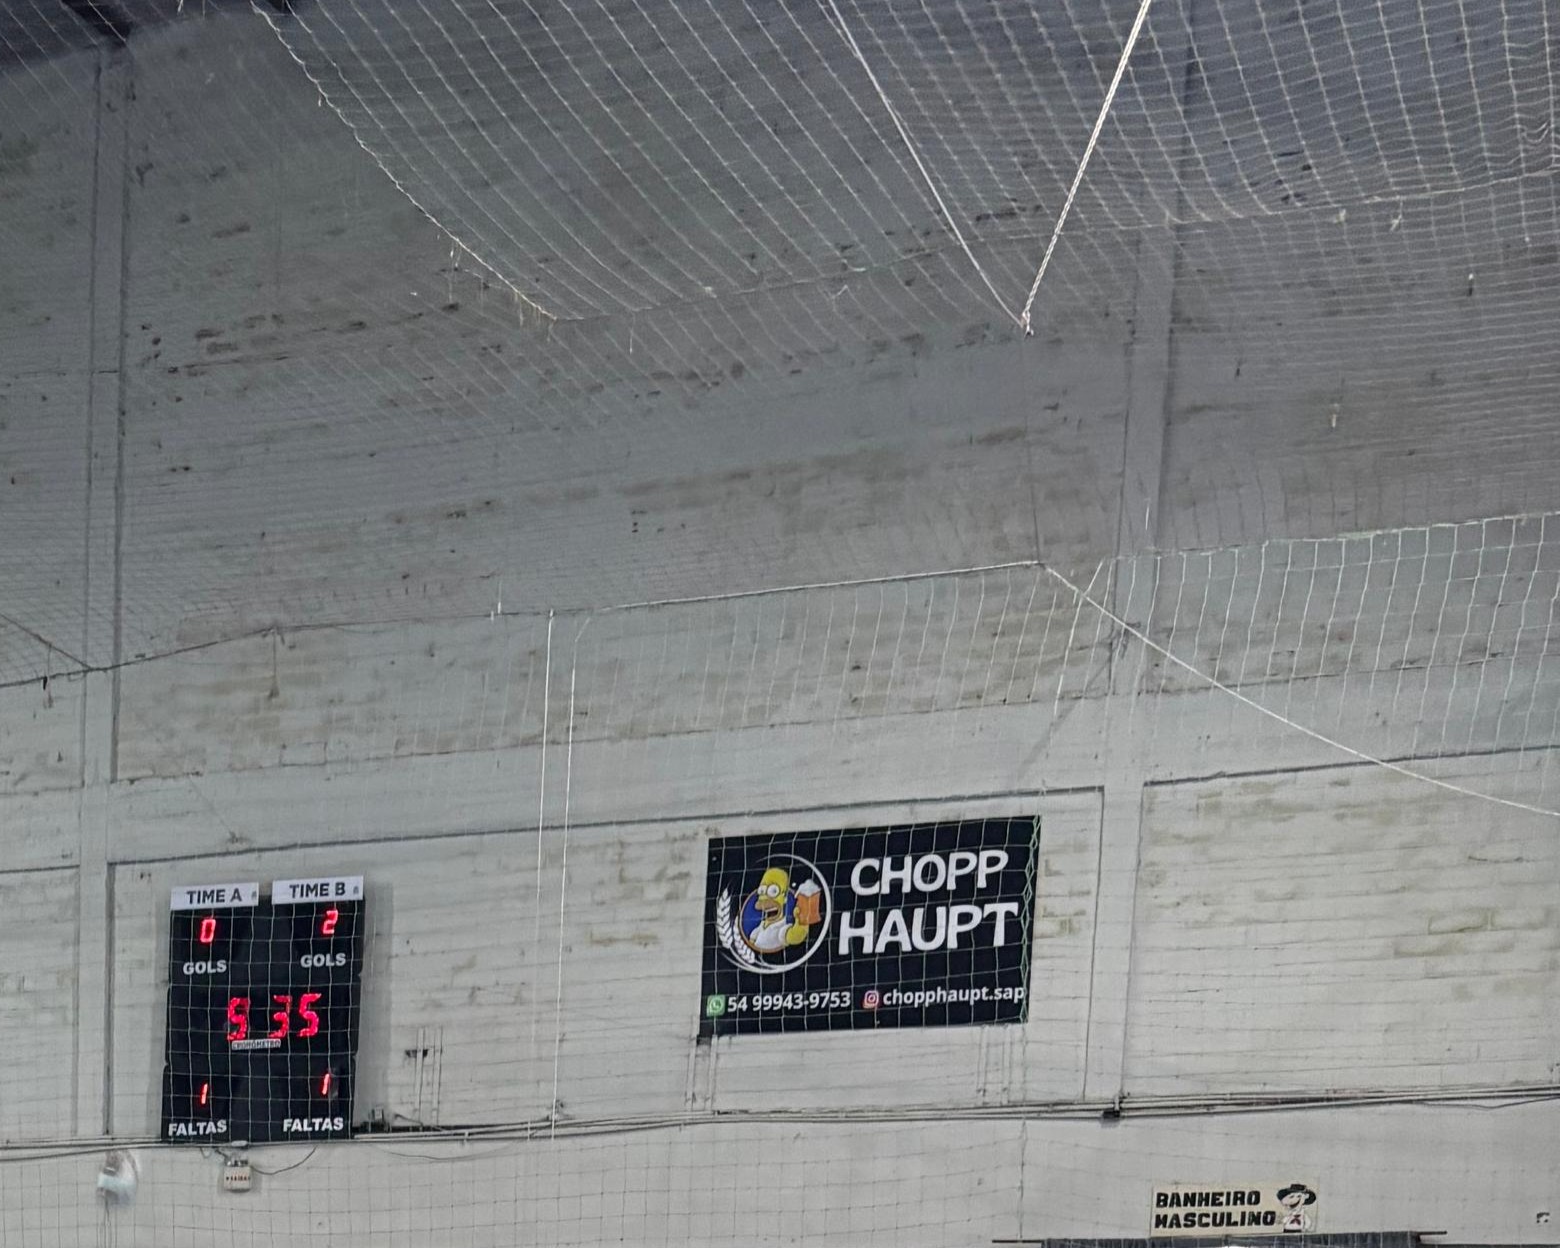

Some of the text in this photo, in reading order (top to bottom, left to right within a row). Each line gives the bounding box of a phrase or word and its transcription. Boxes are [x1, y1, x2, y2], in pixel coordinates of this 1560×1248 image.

[850, 849, 1009, 896] CHOPP
[187, 888, 243, 905] TIME A
[289, 882, 346, 899] TIME B
[200, 918, 216, 943] 0
[322, 910, 338, 934] 2
[838, 902, 1019, 955] HAUPT
[182, 959, 227, 976] GOLS
[300, 952, 347, 968] GOLS
[727, 991, 852, 1012] 54 99943-9753
[882, 985, 1025, 1009] chopphaupt.sap
[200, 1082, 209, 1105] 1
[322, 1073, 331, 1096] 1
[167, 1119, 228, 1136] FALTAS
[283, 1117, 344, 1132] FALTAS
[1155, 1191, 1261, 1208] BANHEIRO
[1154, 1210, 1277, 1228] MASCULINO
